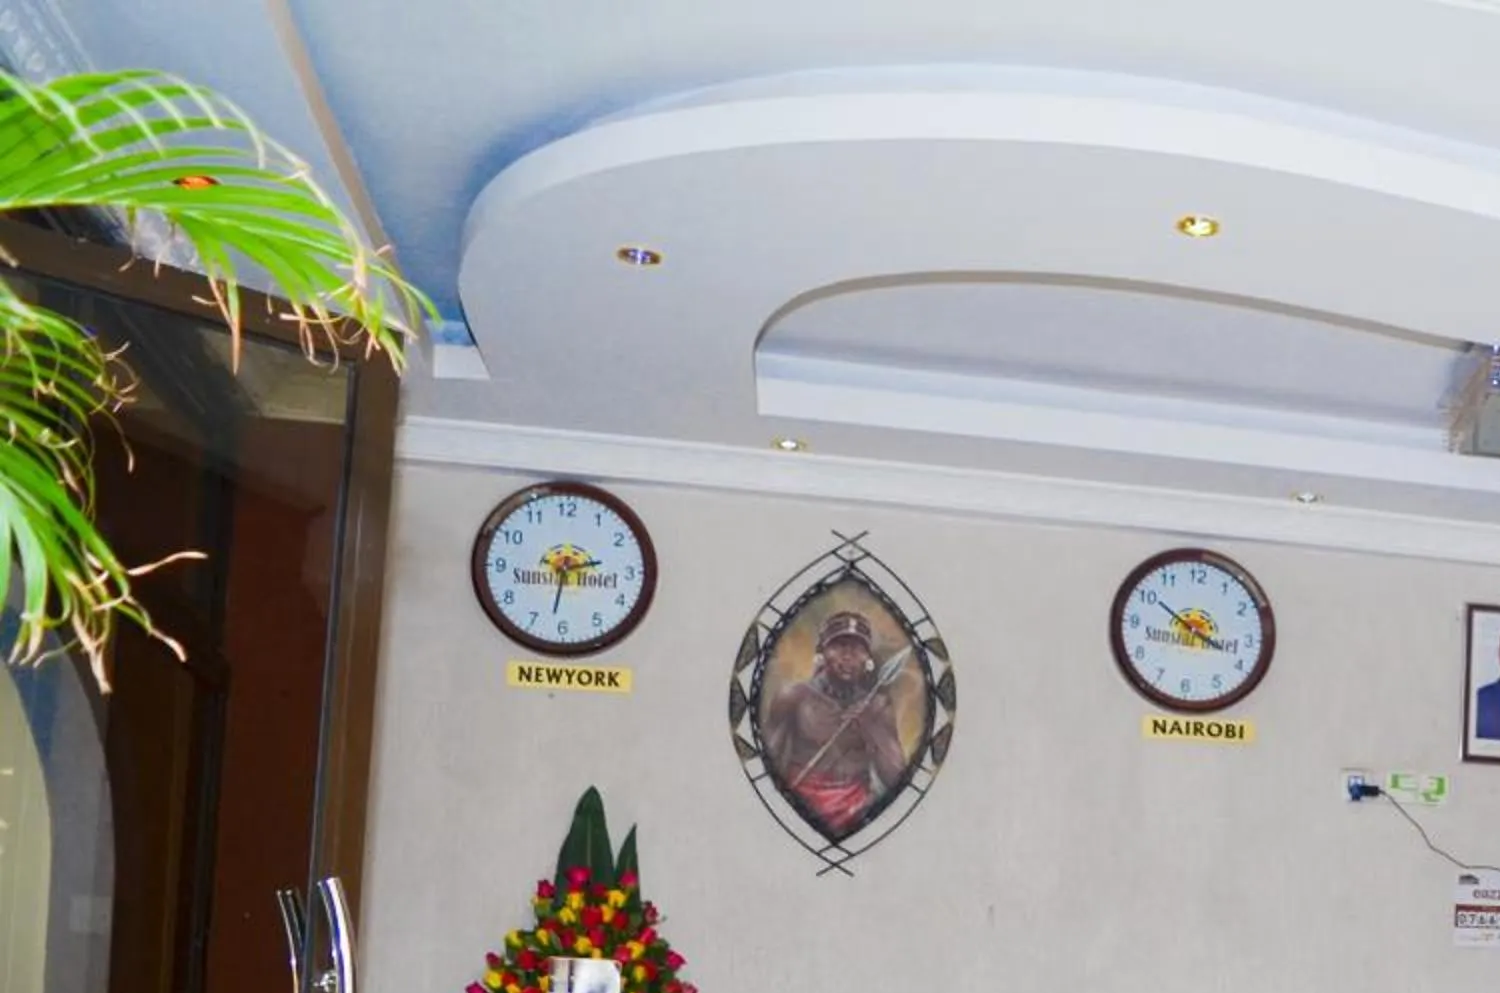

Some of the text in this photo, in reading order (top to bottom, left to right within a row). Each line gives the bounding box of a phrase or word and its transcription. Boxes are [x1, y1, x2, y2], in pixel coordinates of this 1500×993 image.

[527, 511, 543, 525] 11
[557, 503, 577, 518] 12
[594, 513, 602, 527] 1
[503, 529, 523, 546] 10
[613, 532, 625, 547] 2
[495, 557, 507, 573] 9
[577, 570, 618, 589] Hotel
[624, 566, 636, 581] 3
[1161, 573, 1176, 587] 11
[1190, 568, 1207, 585] 12
[1221, 582, 1229, 595] 1
[503, 590, 515, 605] 8
[615, 593, 625, 607] 4
[1139, 590, 1157, 605] 10
[1237, 602, 1247, 616] 2
[528, 611, 539, 626] 7
[592, 612, 602, 627] 5
[1129, 614, 1140, 629] 9
[557, 620, 569, 635] 6
[1201, 636, 1239, 655] Htel
[1245, 634, 1253, 648] 3
[1234, 658, 1243, 671] 4
[518, 666, 620, 687] NEWYORK
[1156, 668, 1165, 682] 7
[1211, 675, 1222, 689] 5
[1180, 678, 1190, 693] 6
[1152, 719, 1245, 739] NAIROBI
